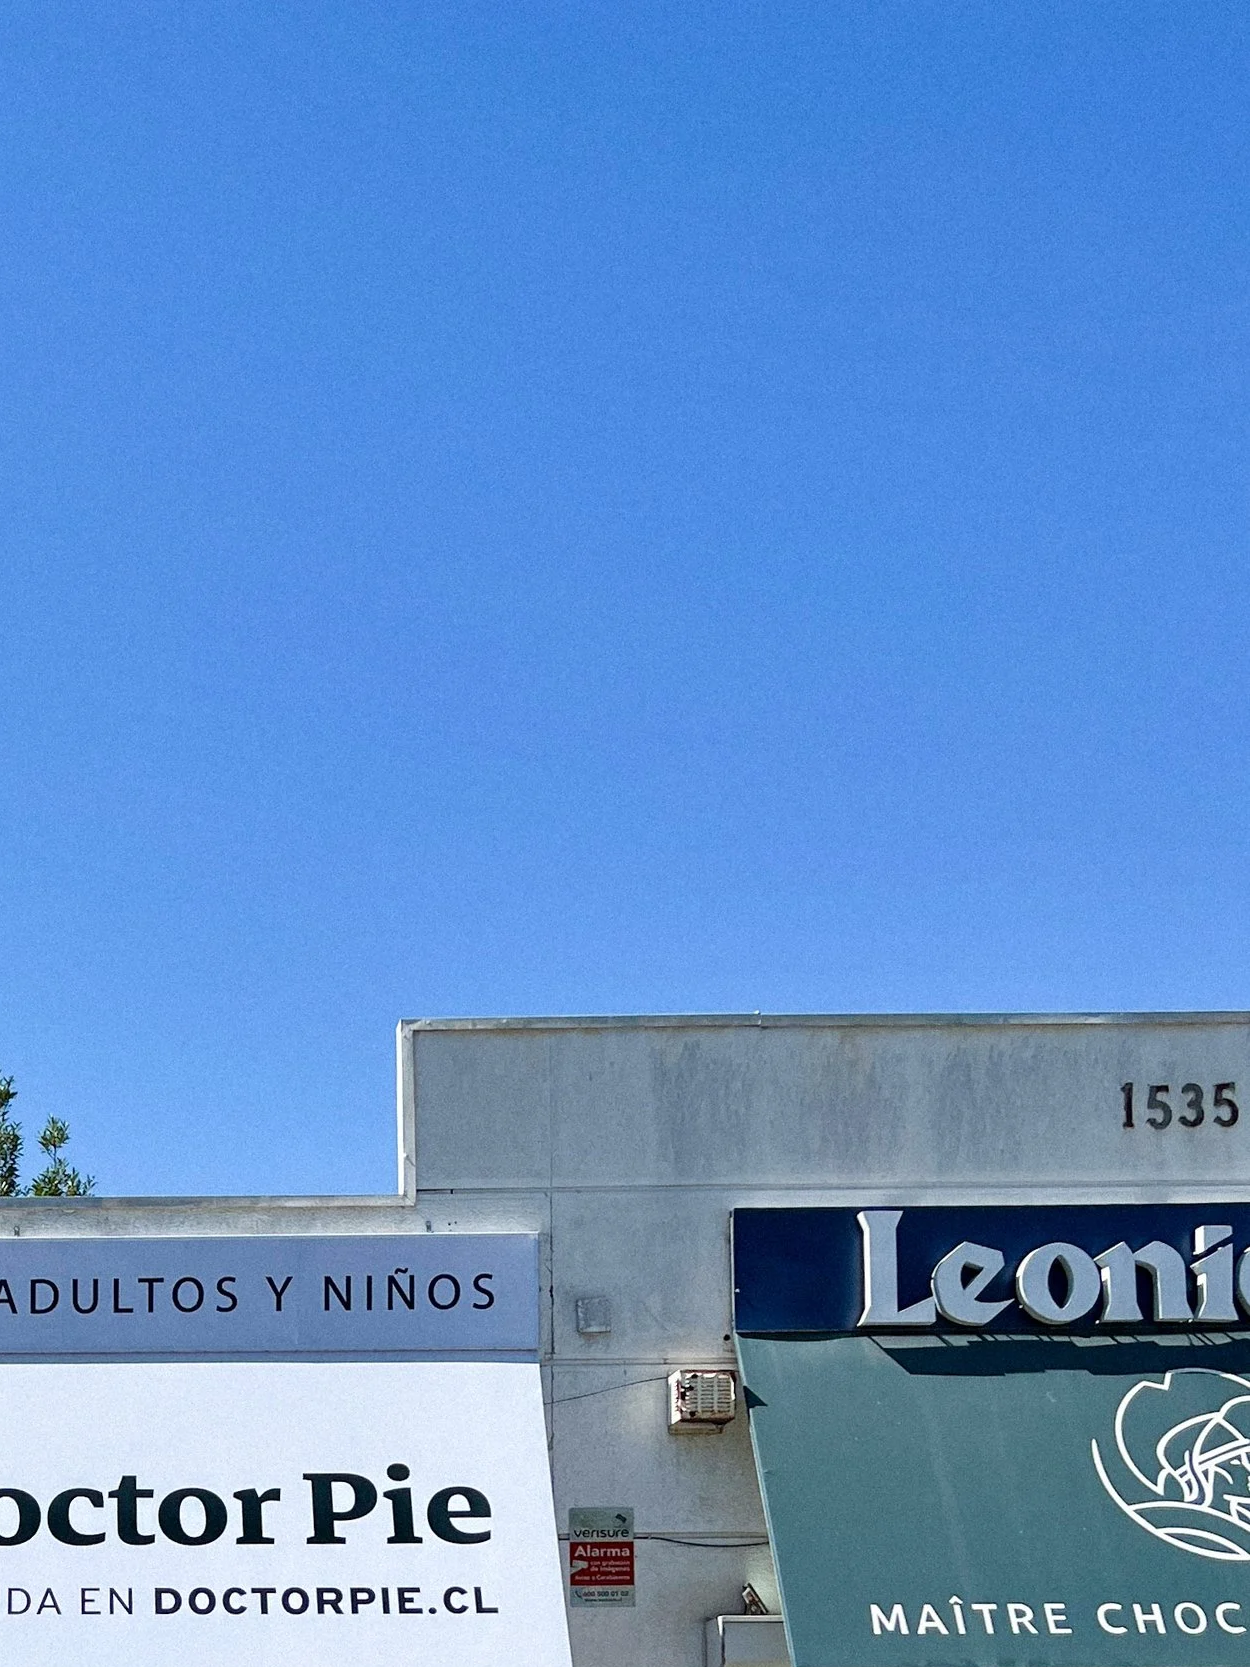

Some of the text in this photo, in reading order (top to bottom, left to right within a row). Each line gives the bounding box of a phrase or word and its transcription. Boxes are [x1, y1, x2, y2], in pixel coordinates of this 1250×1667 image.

[1120, 1081, 1239, 1131] 1535
[857, 1210, 1250, 1326] Leoni
[265, 1276, 294, 1312] Y
[324, 1267, 495, 1312] NIÑOS
[302, 1463, 492, 1546] Pie
[574, 1529, 629, 1538] verisure
[574, 1545, 630, 1557] Alarma
[80, 1587, 133, 1615] EN
[154, 1586, 499, 1615] DOCTORPIE.CL
[869, 1595, 1247, 1635] MAÎTRE CHOC
